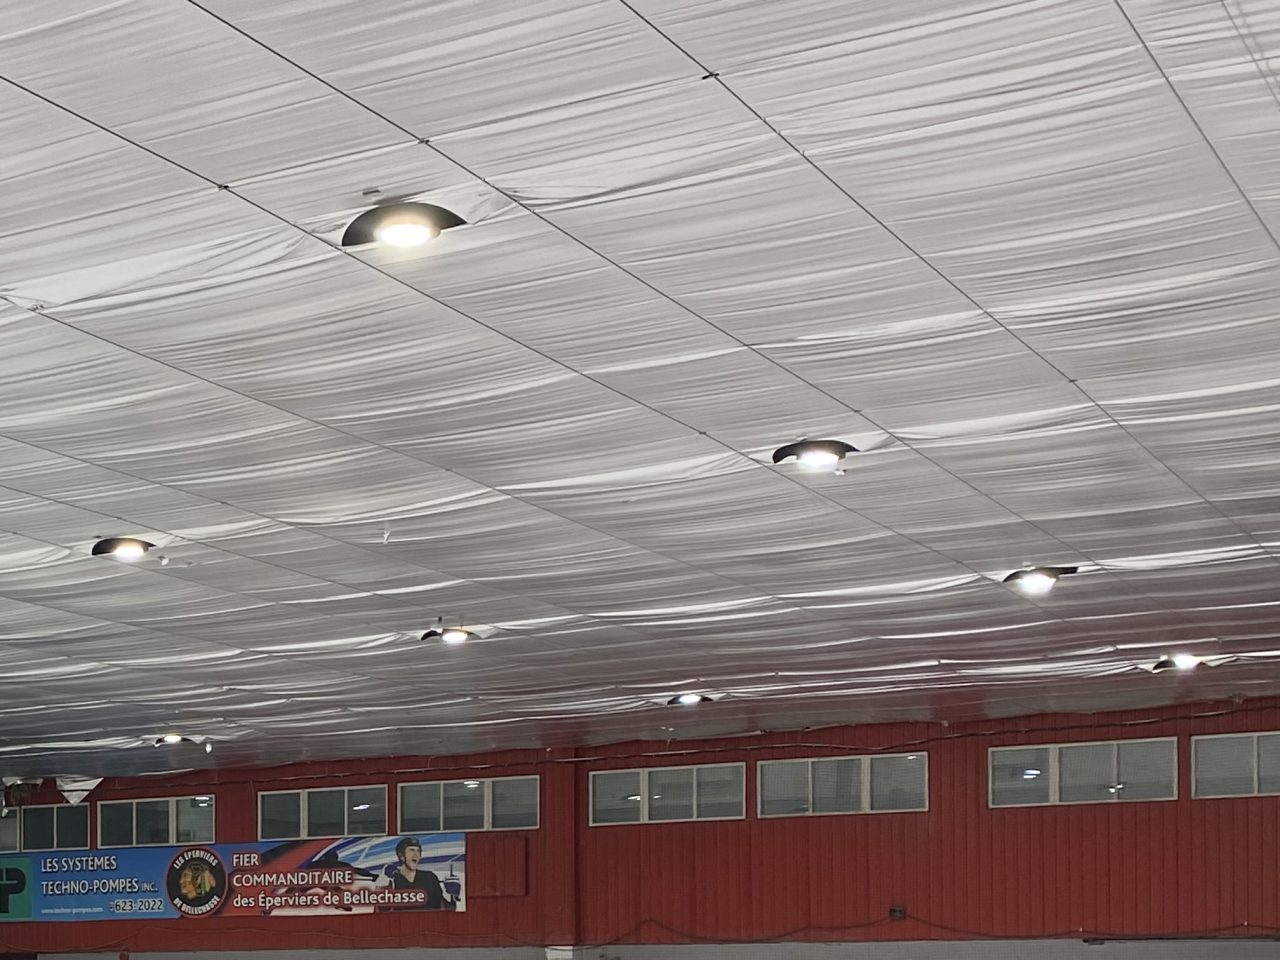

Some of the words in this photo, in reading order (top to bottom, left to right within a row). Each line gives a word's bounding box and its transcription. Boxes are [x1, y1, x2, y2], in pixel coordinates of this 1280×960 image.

[41, 858, 58, 872] LES
[62, 853, 117, 872] SYSTÈMES
[233, 855, 259, 868] FIER
[41, 878, 138, 895] TECHNO-POMPES
[142, 882, 158, 892] INC.
[233, 871, 352, 887] COMMANDITAIRE
[115, 899, 164, 911] 623-2022
[233, 893, 255, 907] des
[258, 892, 320, 909] Éperviers
[322, 892, 340, 906] de
[344, 889, 425, 905] Bellechasse
